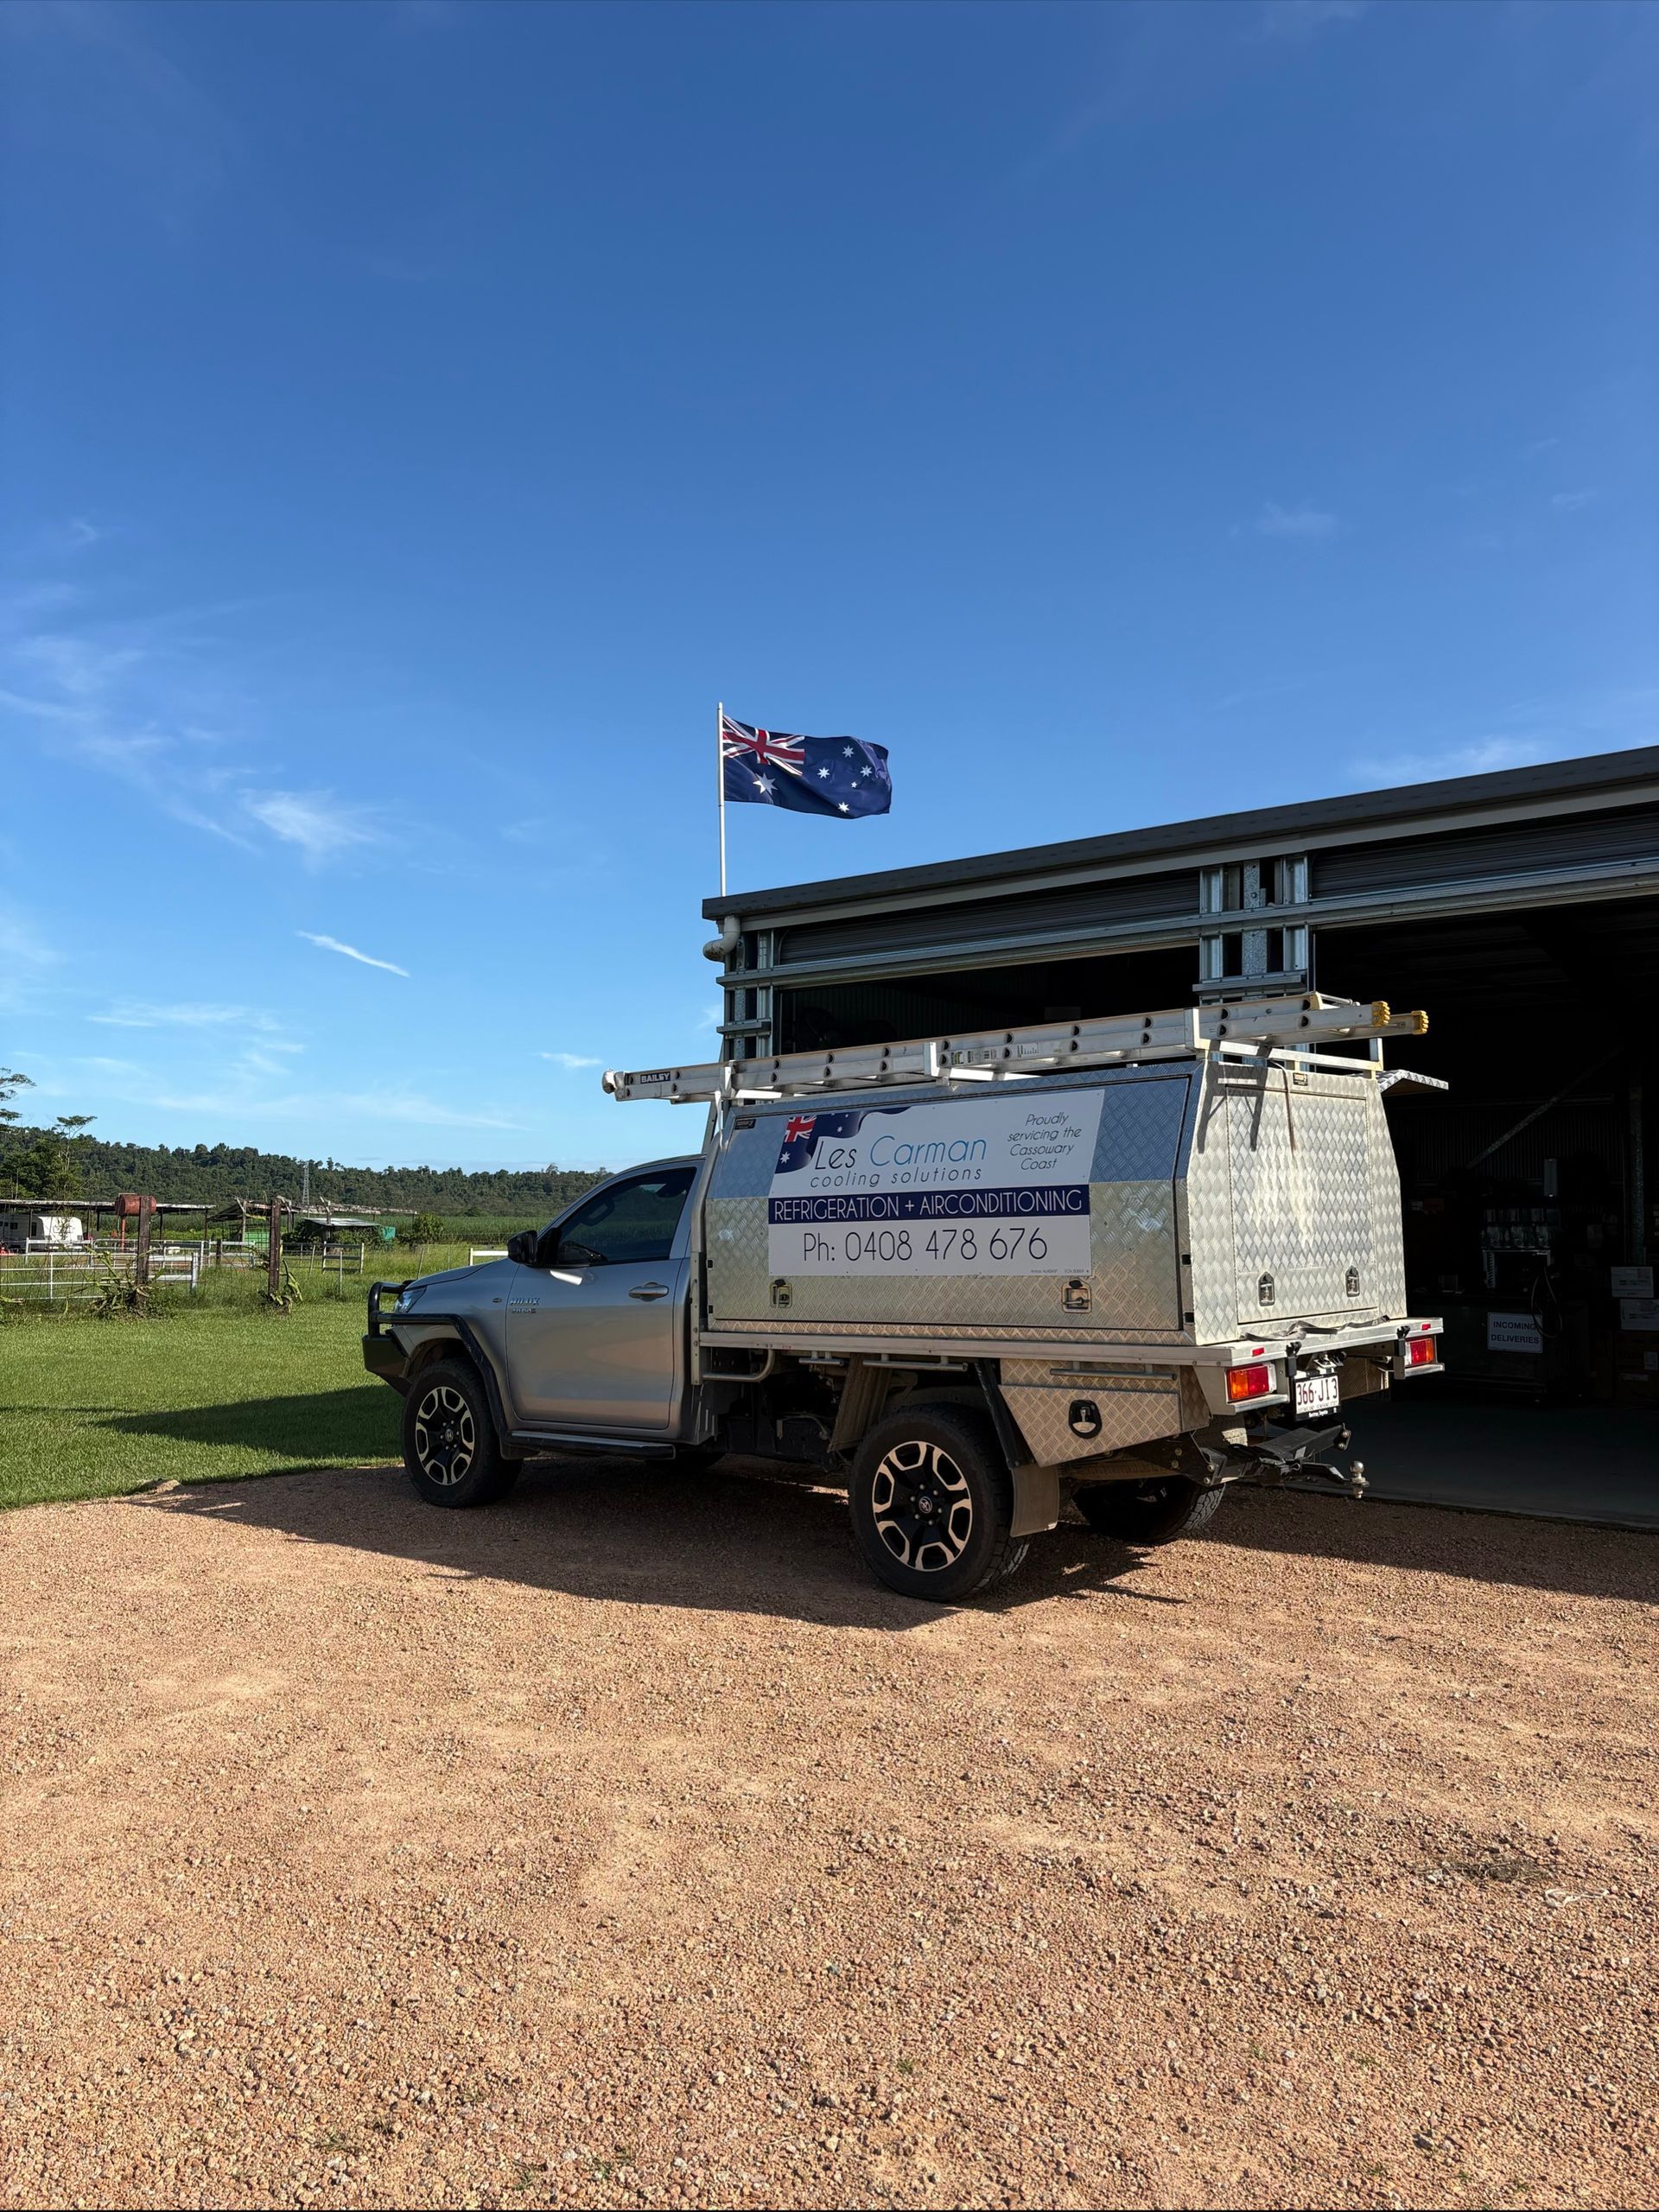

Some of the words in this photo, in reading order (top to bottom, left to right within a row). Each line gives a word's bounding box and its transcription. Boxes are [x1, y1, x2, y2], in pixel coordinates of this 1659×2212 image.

[641, 1072, 671, 1083] BAILEY
[1025, 1111, 1070, 1126] Proudly
[1007, 1129, 1059, 1141] servicing
[1063, 1126, 1082, 1138] the
[815, 1141, 857, 1170] Les
[870, 1135, 987, 1166] Carman
[1009, 1143, 1075, 1156] Cassowary
[1020, 1158, 1058, 1170] Coast
[810, 1170, 880, 1188] cooling
[891, 1166, 982, 1185] solutions
[774, 1196, 899, 1221] REFRIGERATION
[905, 1200, 915, 1212] +
[919, 1190, 1082, 1216] AIRCONDITIONING
[804, 1232, 836, 1262] Ph:
[845, 1230, 912, 1262] 0408
[925, 1228, 978, 1261] 478
[989, 1227, 1048, 1261] 676
[1493, 1320, 1536, 1331] INCOMING
[1491, 1333, 1540, 1344] DELIVERIES
